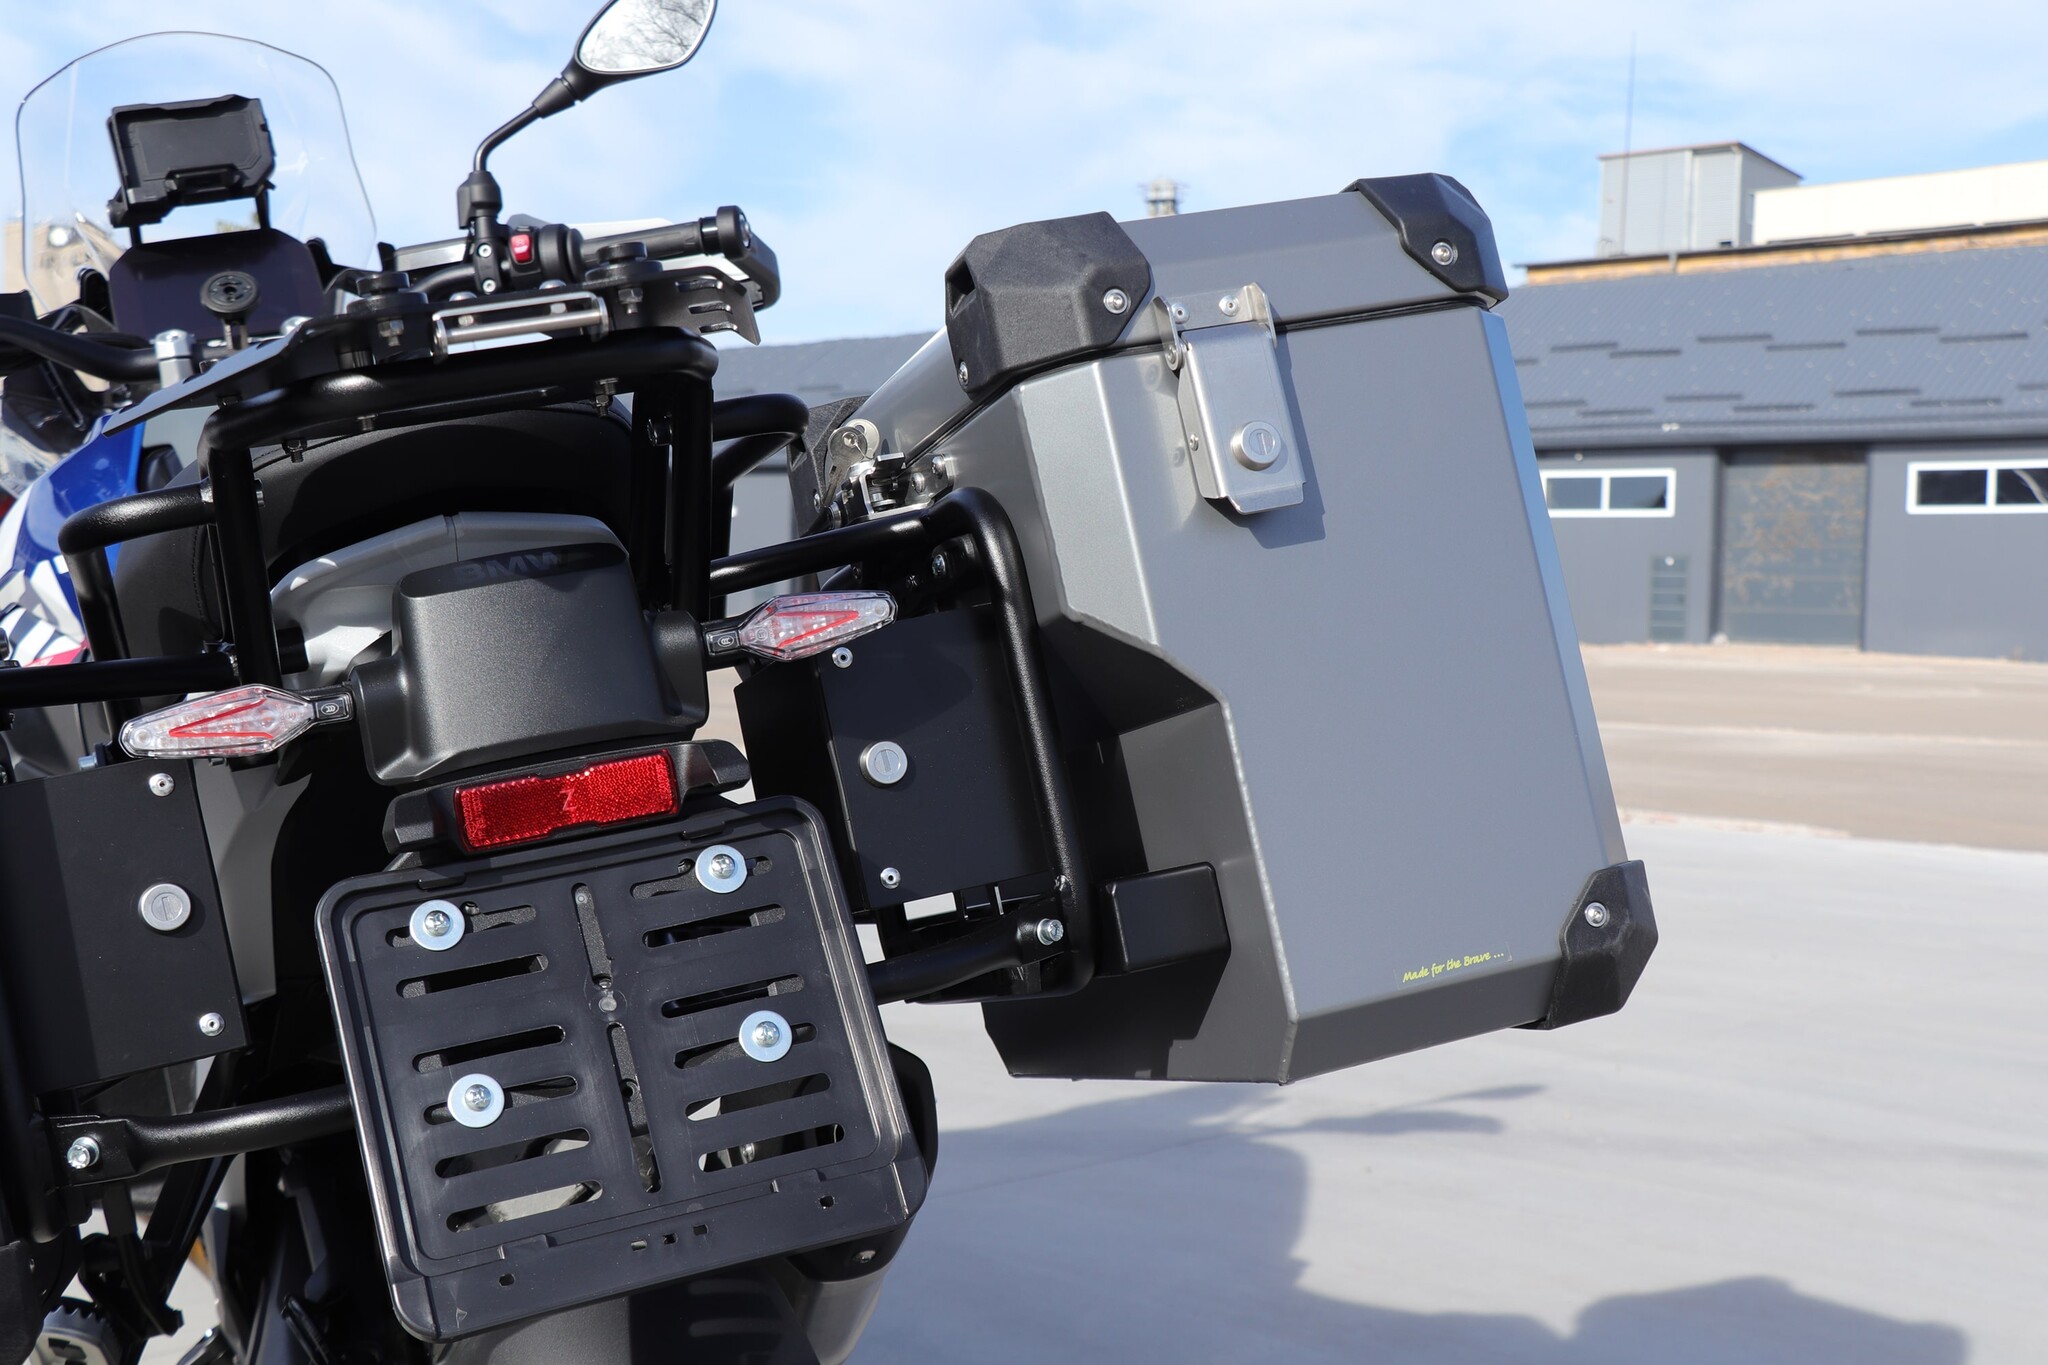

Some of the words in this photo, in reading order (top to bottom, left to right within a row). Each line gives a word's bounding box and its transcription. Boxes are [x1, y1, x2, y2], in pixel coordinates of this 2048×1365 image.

[1402, 966, 1430, 983] Made
[1431, 963, 1445, 978] for
[1446, 958, 1462, 971] the
[1463, 951, 1491, 967] Brave
